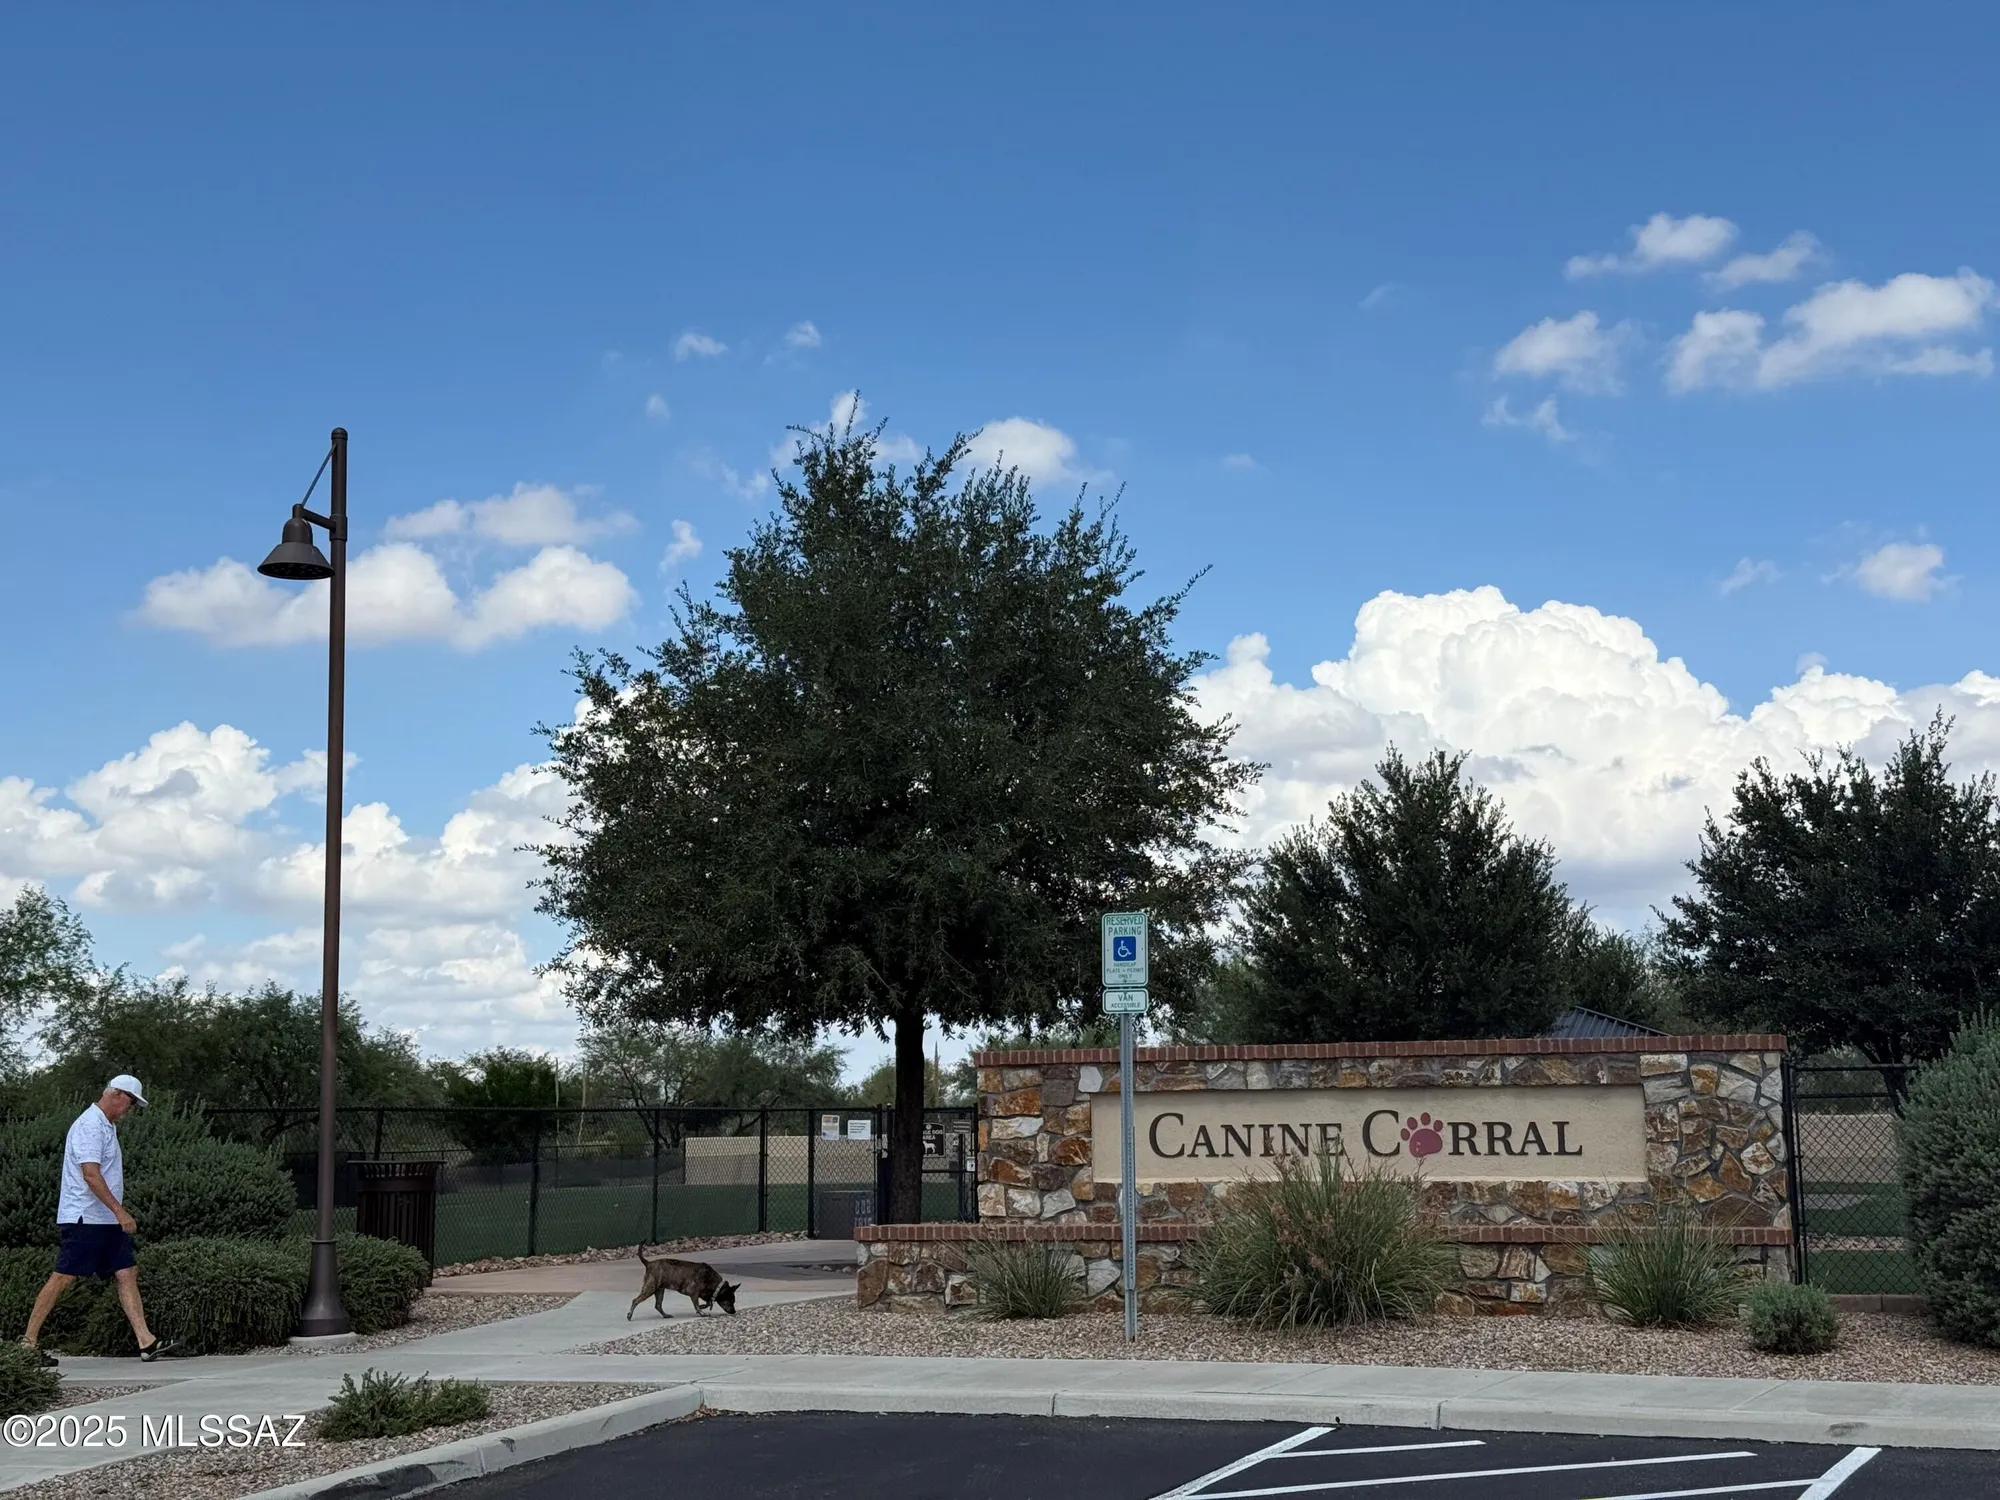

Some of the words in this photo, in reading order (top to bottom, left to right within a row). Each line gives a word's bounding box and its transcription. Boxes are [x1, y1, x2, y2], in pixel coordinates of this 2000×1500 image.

[1106, 916, 1144, 925] RESERVED
[1108, 926, 1142, 936] PARKING
[1118, 994, 1134, 1002] VAN
